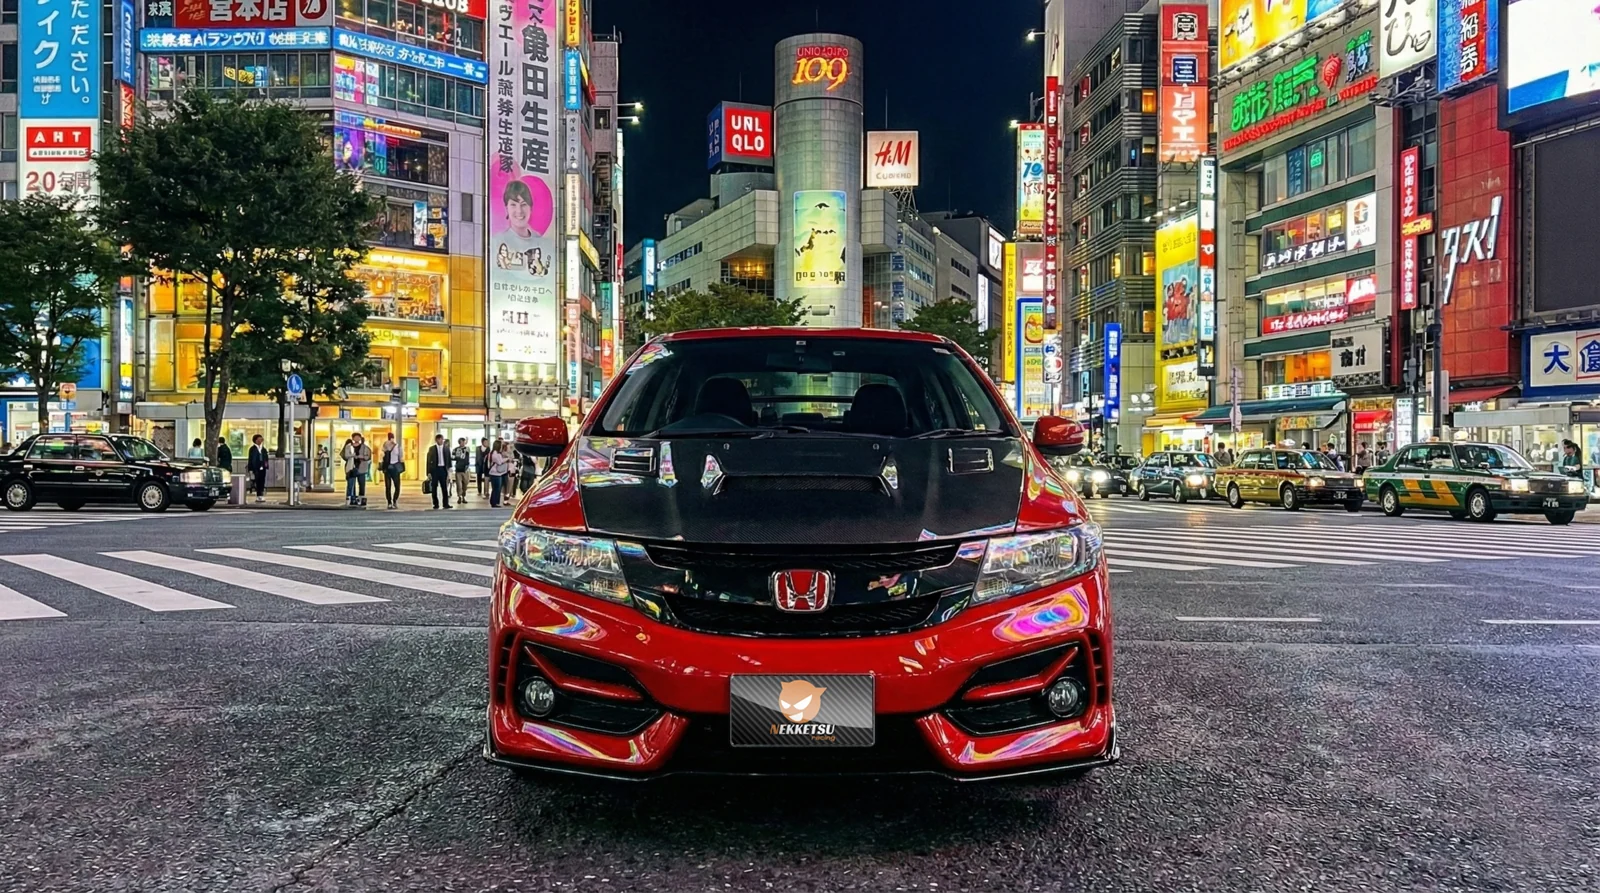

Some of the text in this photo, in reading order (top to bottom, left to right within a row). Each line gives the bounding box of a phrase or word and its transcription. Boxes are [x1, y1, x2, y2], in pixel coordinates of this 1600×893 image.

[33, 0, 60, 69] イク
[792, 57, 847, 91] 109
[731, 134, 765, 152] QLO
[769, 724, 835, 735] NEKKETSU
